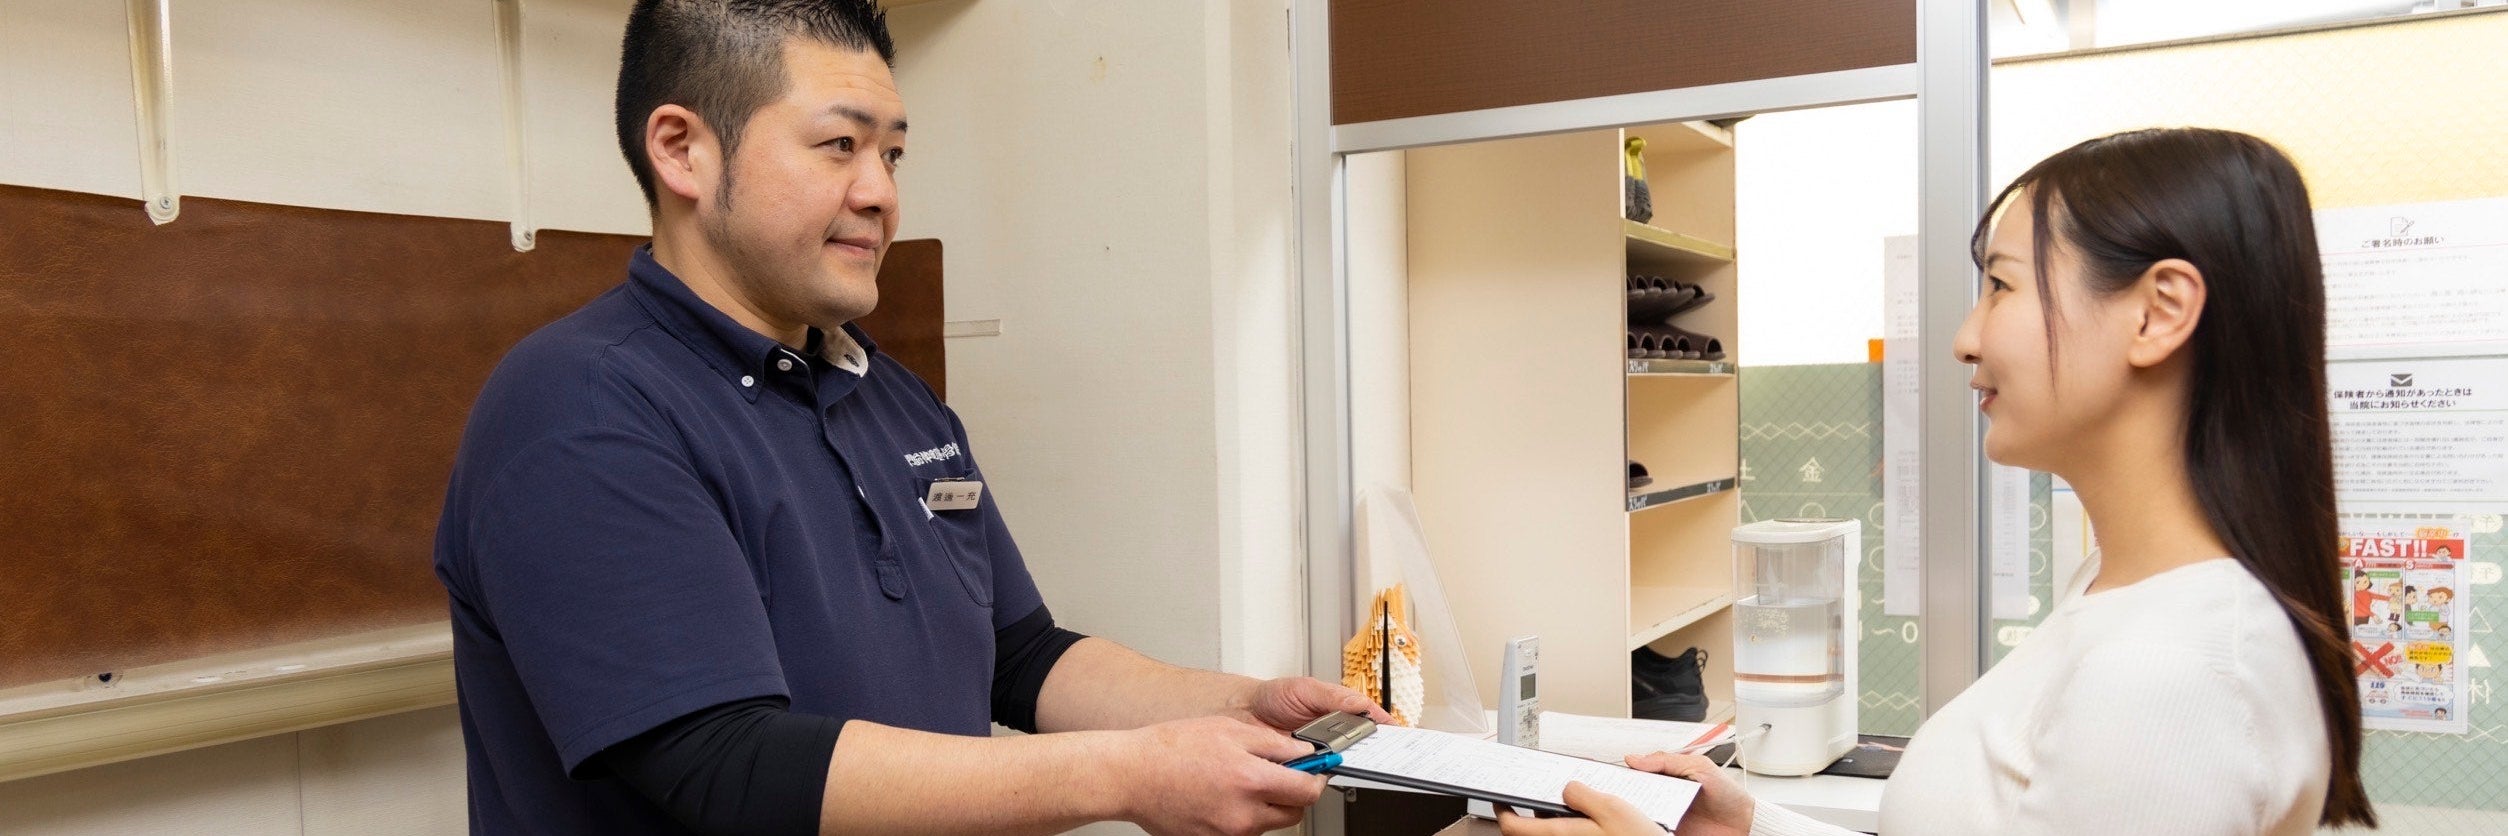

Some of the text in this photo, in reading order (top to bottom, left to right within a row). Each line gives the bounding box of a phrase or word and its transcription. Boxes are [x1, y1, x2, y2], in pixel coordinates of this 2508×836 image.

[2361, 236, 2445, 249] ご署名時のお願い
[2333, 388, 2473, 399] 保険者から通知があったときは
[2349, 399, 2457, 410] 当院にお知らせください
[2349, 539, 2428, 558] FAST!!
